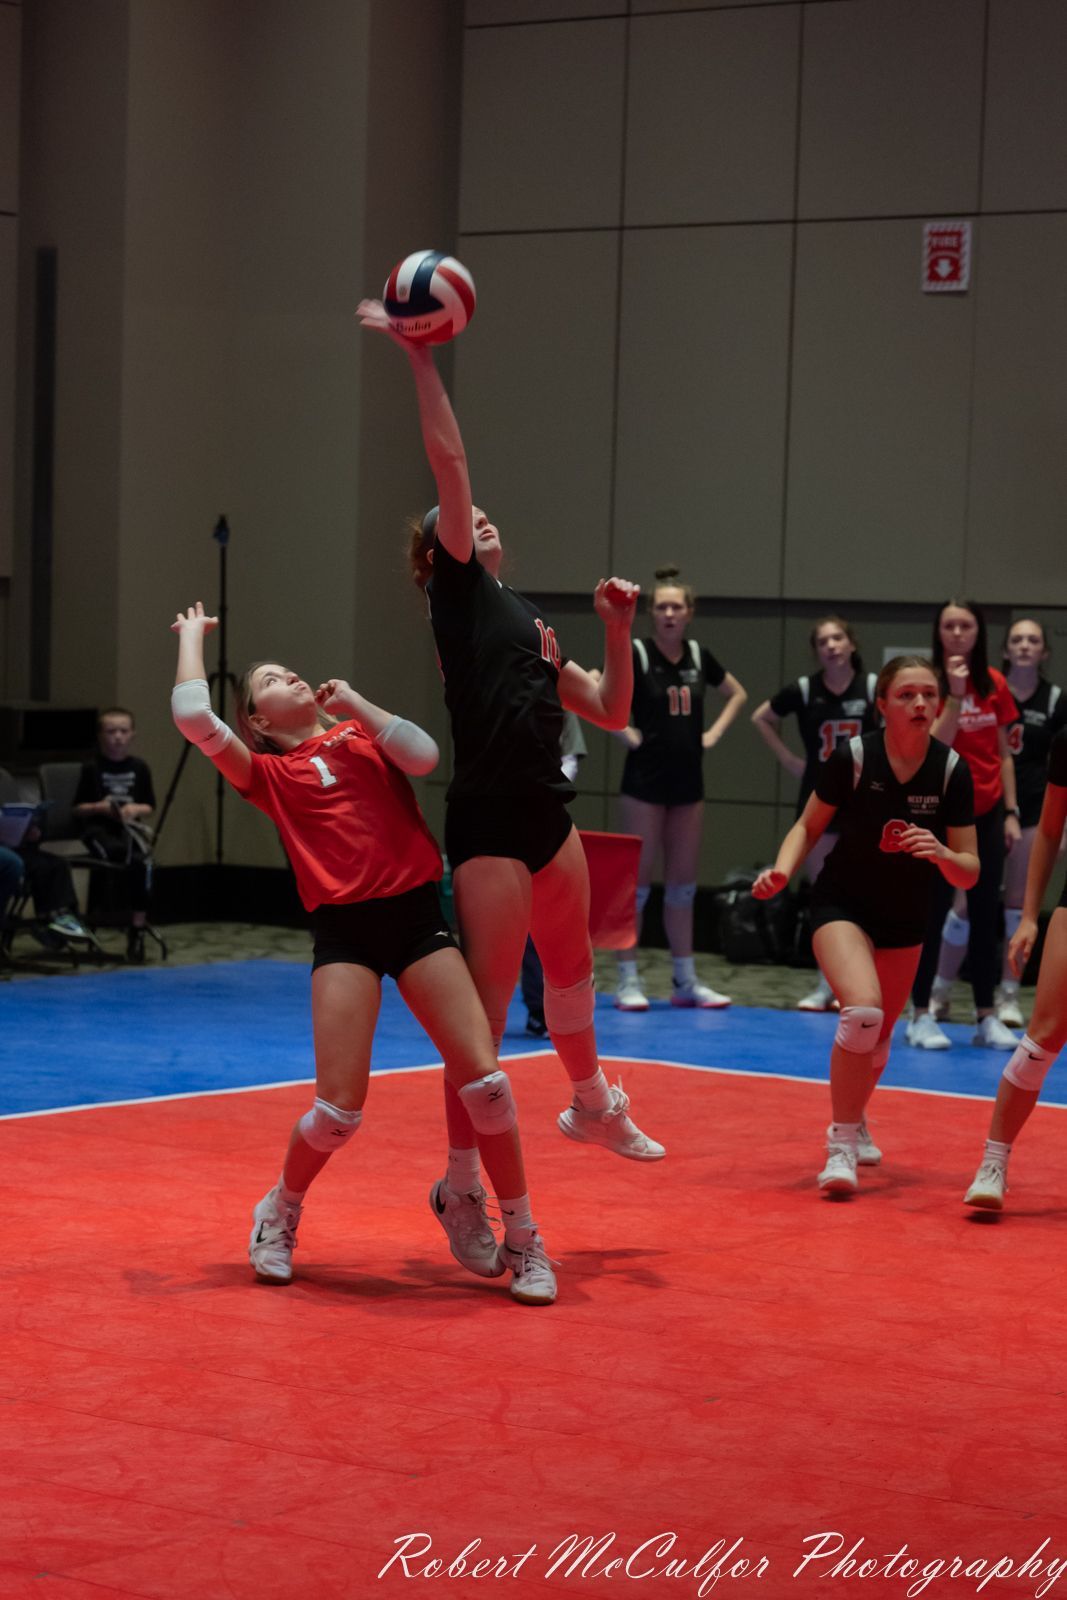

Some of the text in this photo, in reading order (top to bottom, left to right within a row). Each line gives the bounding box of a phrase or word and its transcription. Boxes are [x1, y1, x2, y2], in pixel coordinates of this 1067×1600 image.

[667, 685, 691, 716] 11
[818, 719, 863, 762] 17
[309, 756, 337, 787] 1
